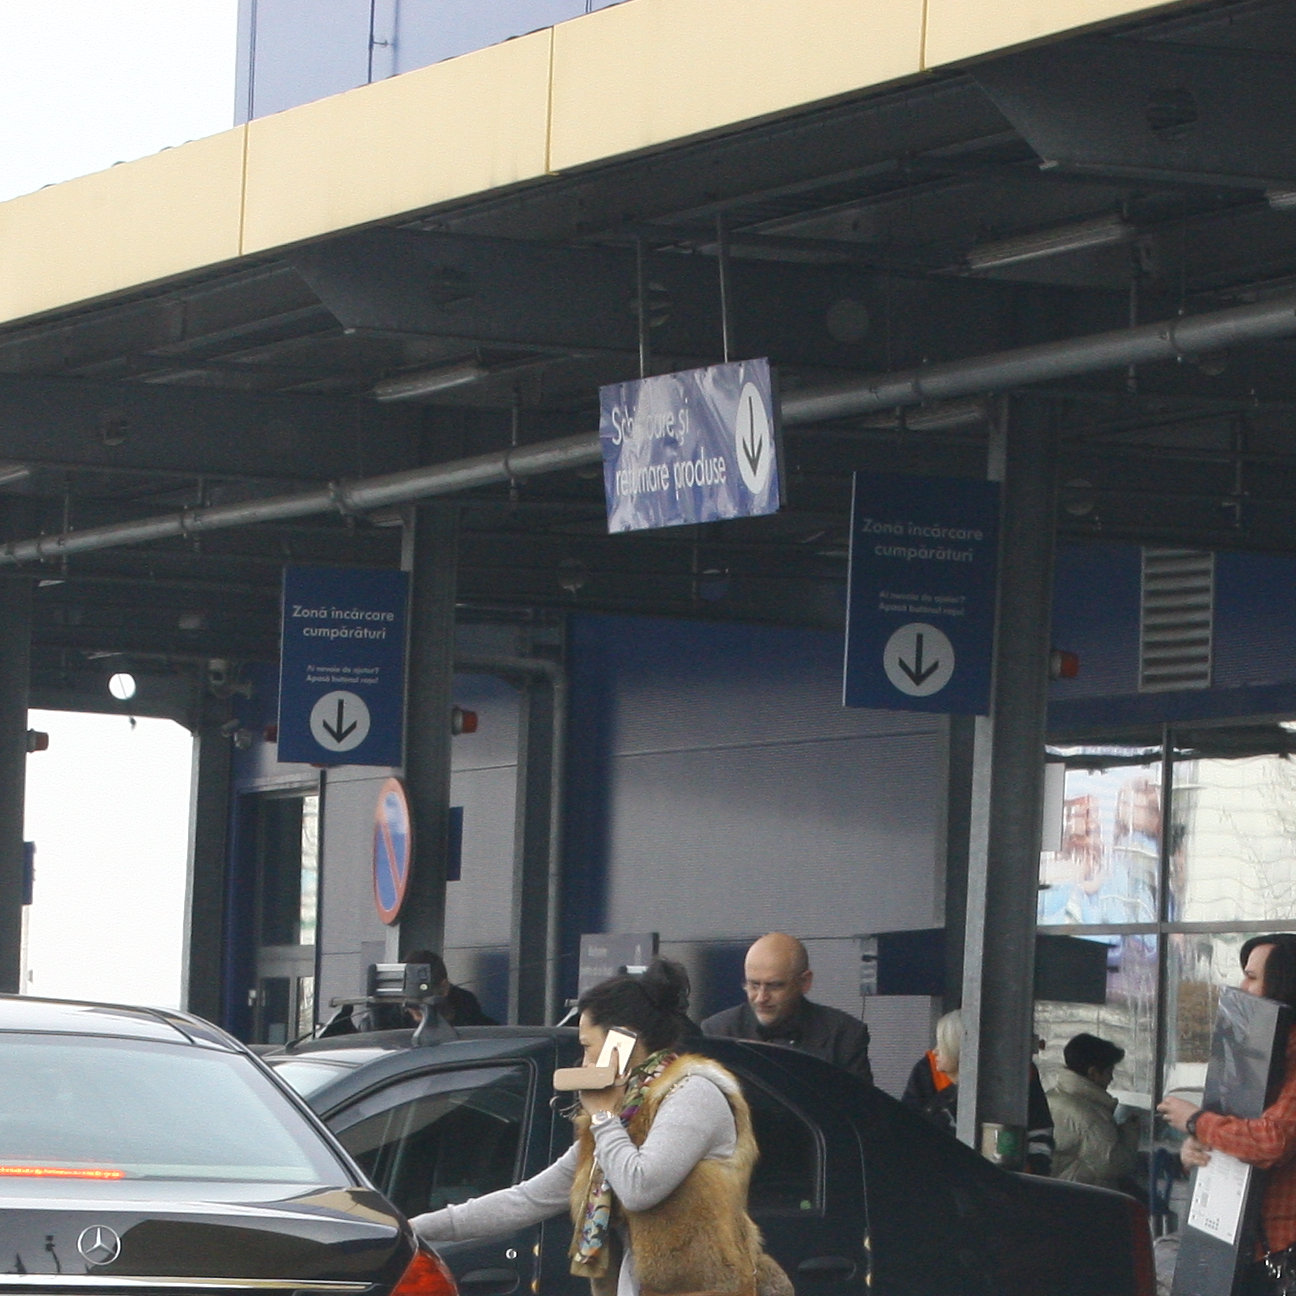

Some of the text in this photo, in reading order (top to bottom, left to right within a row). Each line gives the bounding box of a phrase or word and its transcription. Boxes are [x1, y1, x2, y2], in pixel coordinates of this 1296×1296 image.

[674, 446, 727, 501] produse
[908, 521, 983, 541] încărcare
[874, 544, 973, 562] cumpărături
[292, 605, 395, 621] Zonă încărcare
[303, 626, 386, 640] cumpărături
